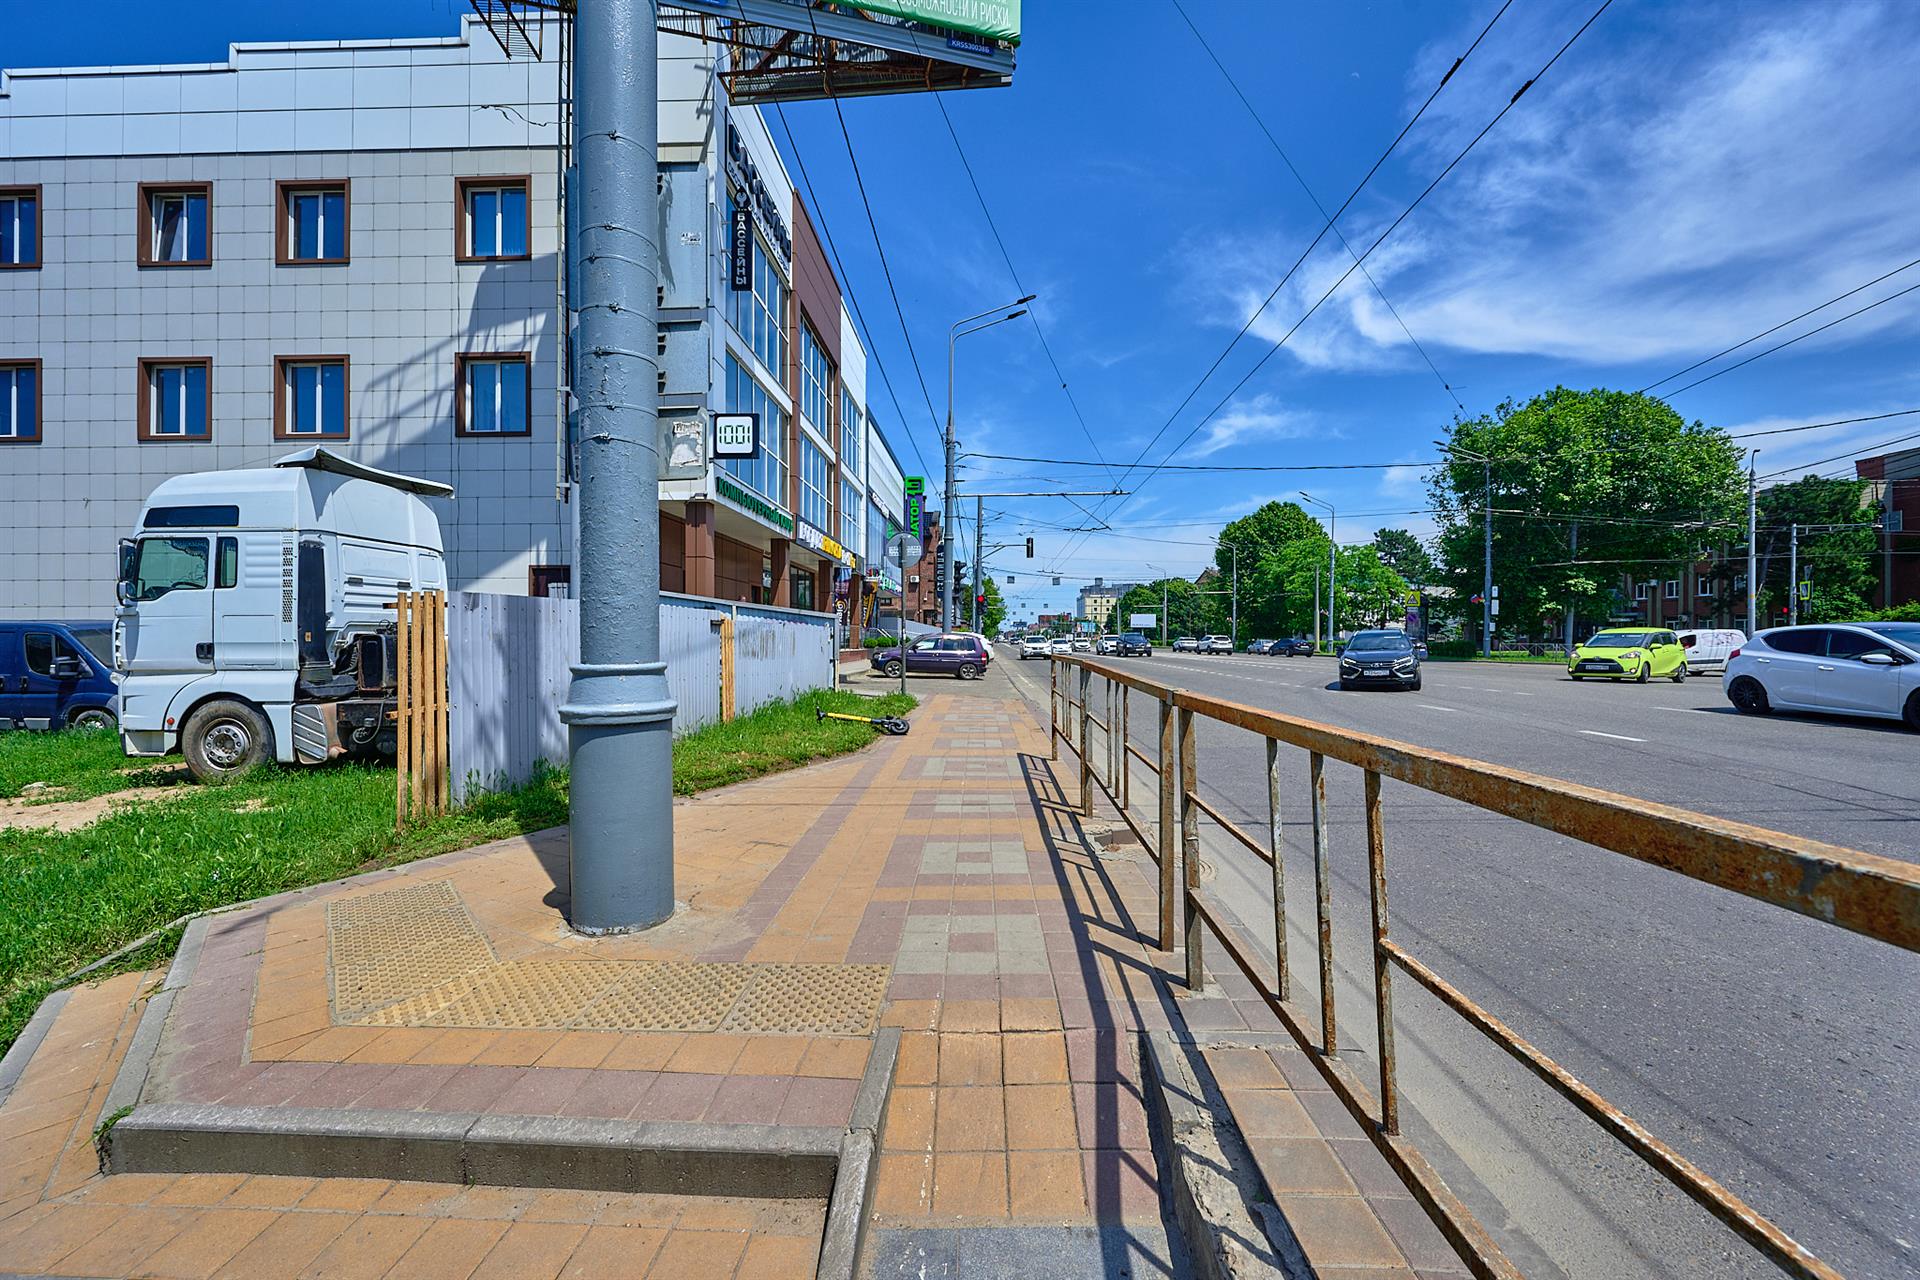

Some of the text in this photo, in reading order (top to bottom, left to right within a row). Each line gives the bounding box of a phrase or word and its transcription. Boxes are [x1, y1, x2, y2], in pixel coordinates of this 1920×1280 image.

[901, 0, 969, 18] МОЖНОСТИ
[971, 0, 978, 20] И
[736, 212, 747, 285] БАССЕЙНЫ
[715, 476, 780, 526] КОМПЬЮТЕРНЫЙ
